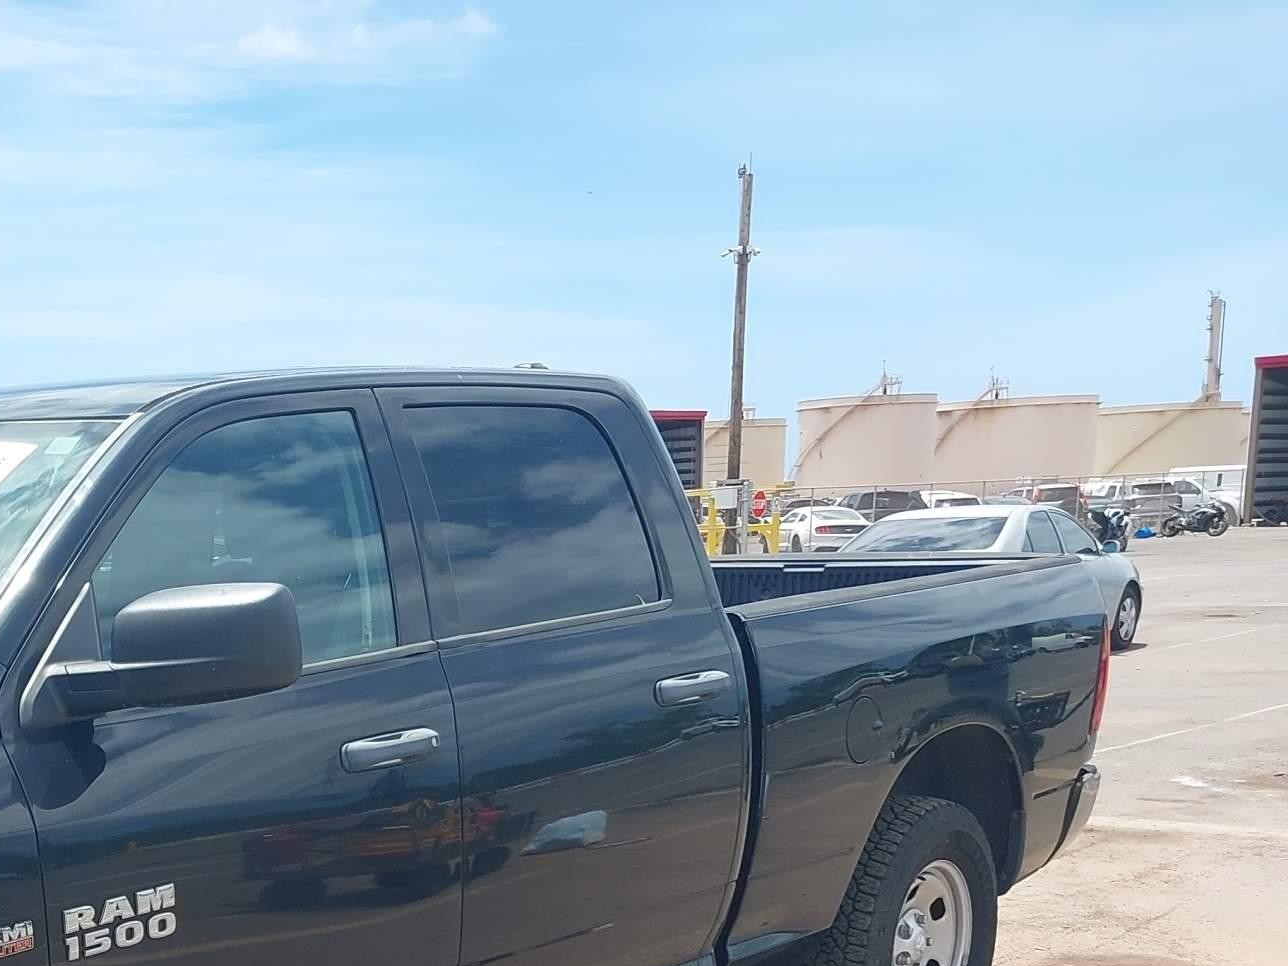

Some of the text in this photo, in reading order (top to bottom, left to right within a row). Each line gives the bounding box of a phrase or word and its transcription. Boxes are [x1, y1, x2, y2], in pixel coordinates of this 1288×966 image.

[753, 499, 766, 510] STOP
[62, 882, 177, 935] RAM
[64, 911, 178, 961] 1500
